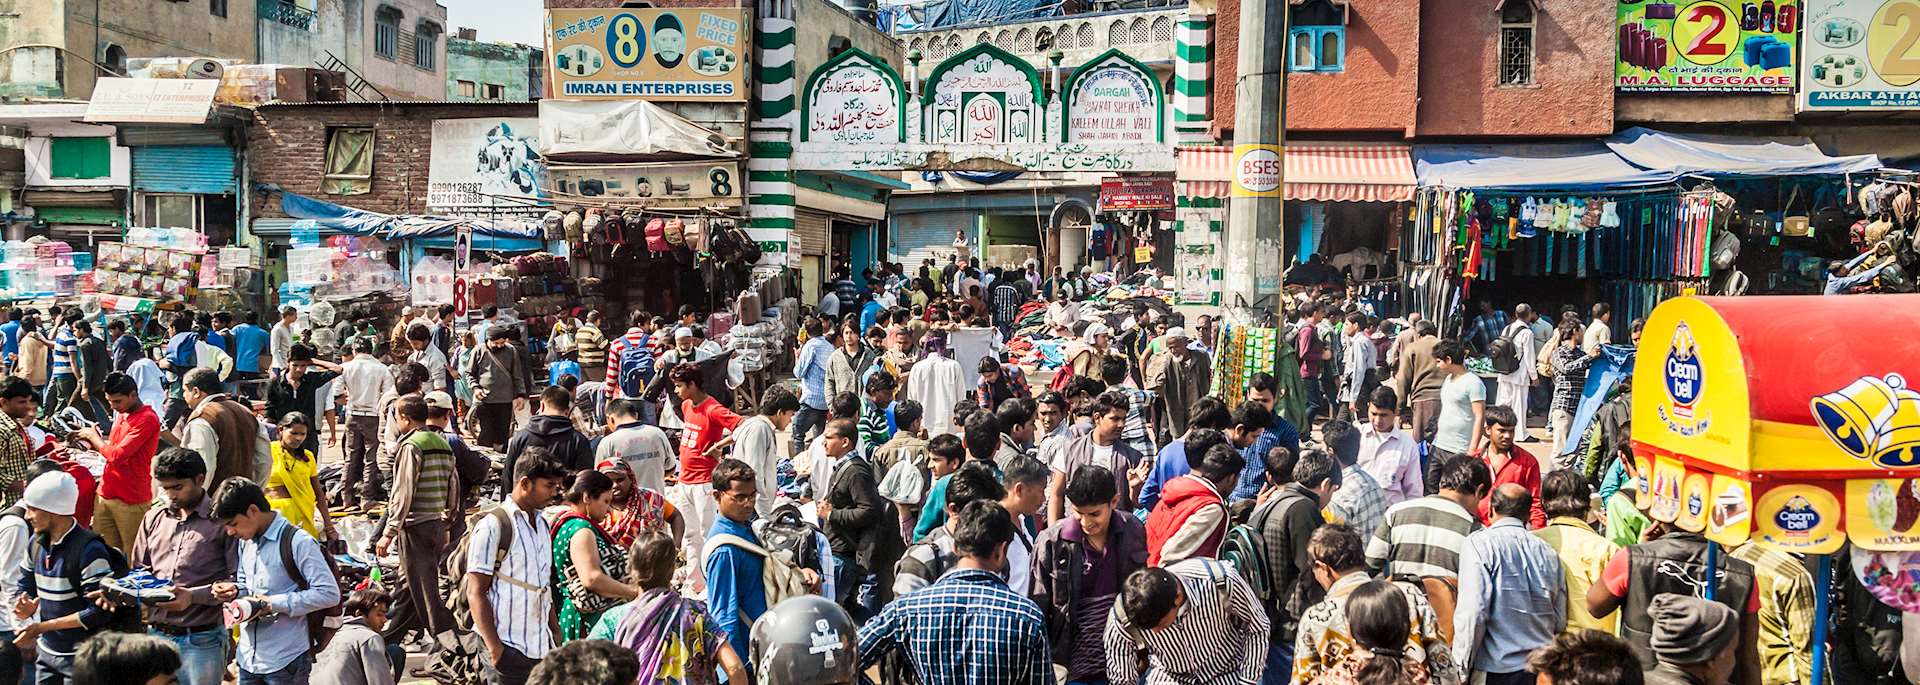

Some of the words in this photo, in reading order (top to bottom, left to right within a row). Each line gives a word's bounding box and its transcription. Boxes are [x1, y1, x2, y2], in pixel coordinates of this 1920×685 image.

[700, 13, 738, 33] FIXED
[1685, 5, 1726, 56] 2
[614, 16, 639, 64] 8
[697, 26, 736, 46] PRICE
[565, 83, 617, 94] IMRAN
[622, 83, 733, 94] ENTERPRISES
[1620, 76, 1669, 86] M.A.
[1677, 76, 1792, 86] LUGGAGE
[1094, 87, 1130, 97] DARGAH
[1817, 92, 1872, 100] AKBAR
[1876, 92, 1920, 100] ATTA
[1071, 117, 1099, 129] KALEEM
[1243, 160, 1280, 175] BSES
[431, 183, 483, 192] 9990126287
[709, 168, 732, 197] 8
[455, 278, 467, 317] 8
[1668, 358, 1698, 381] Cream
[1674, 378, 1693, 399] bell
[1779, 511, 1815, 521] Cream
[1787, 518, 1808, 530] bell
